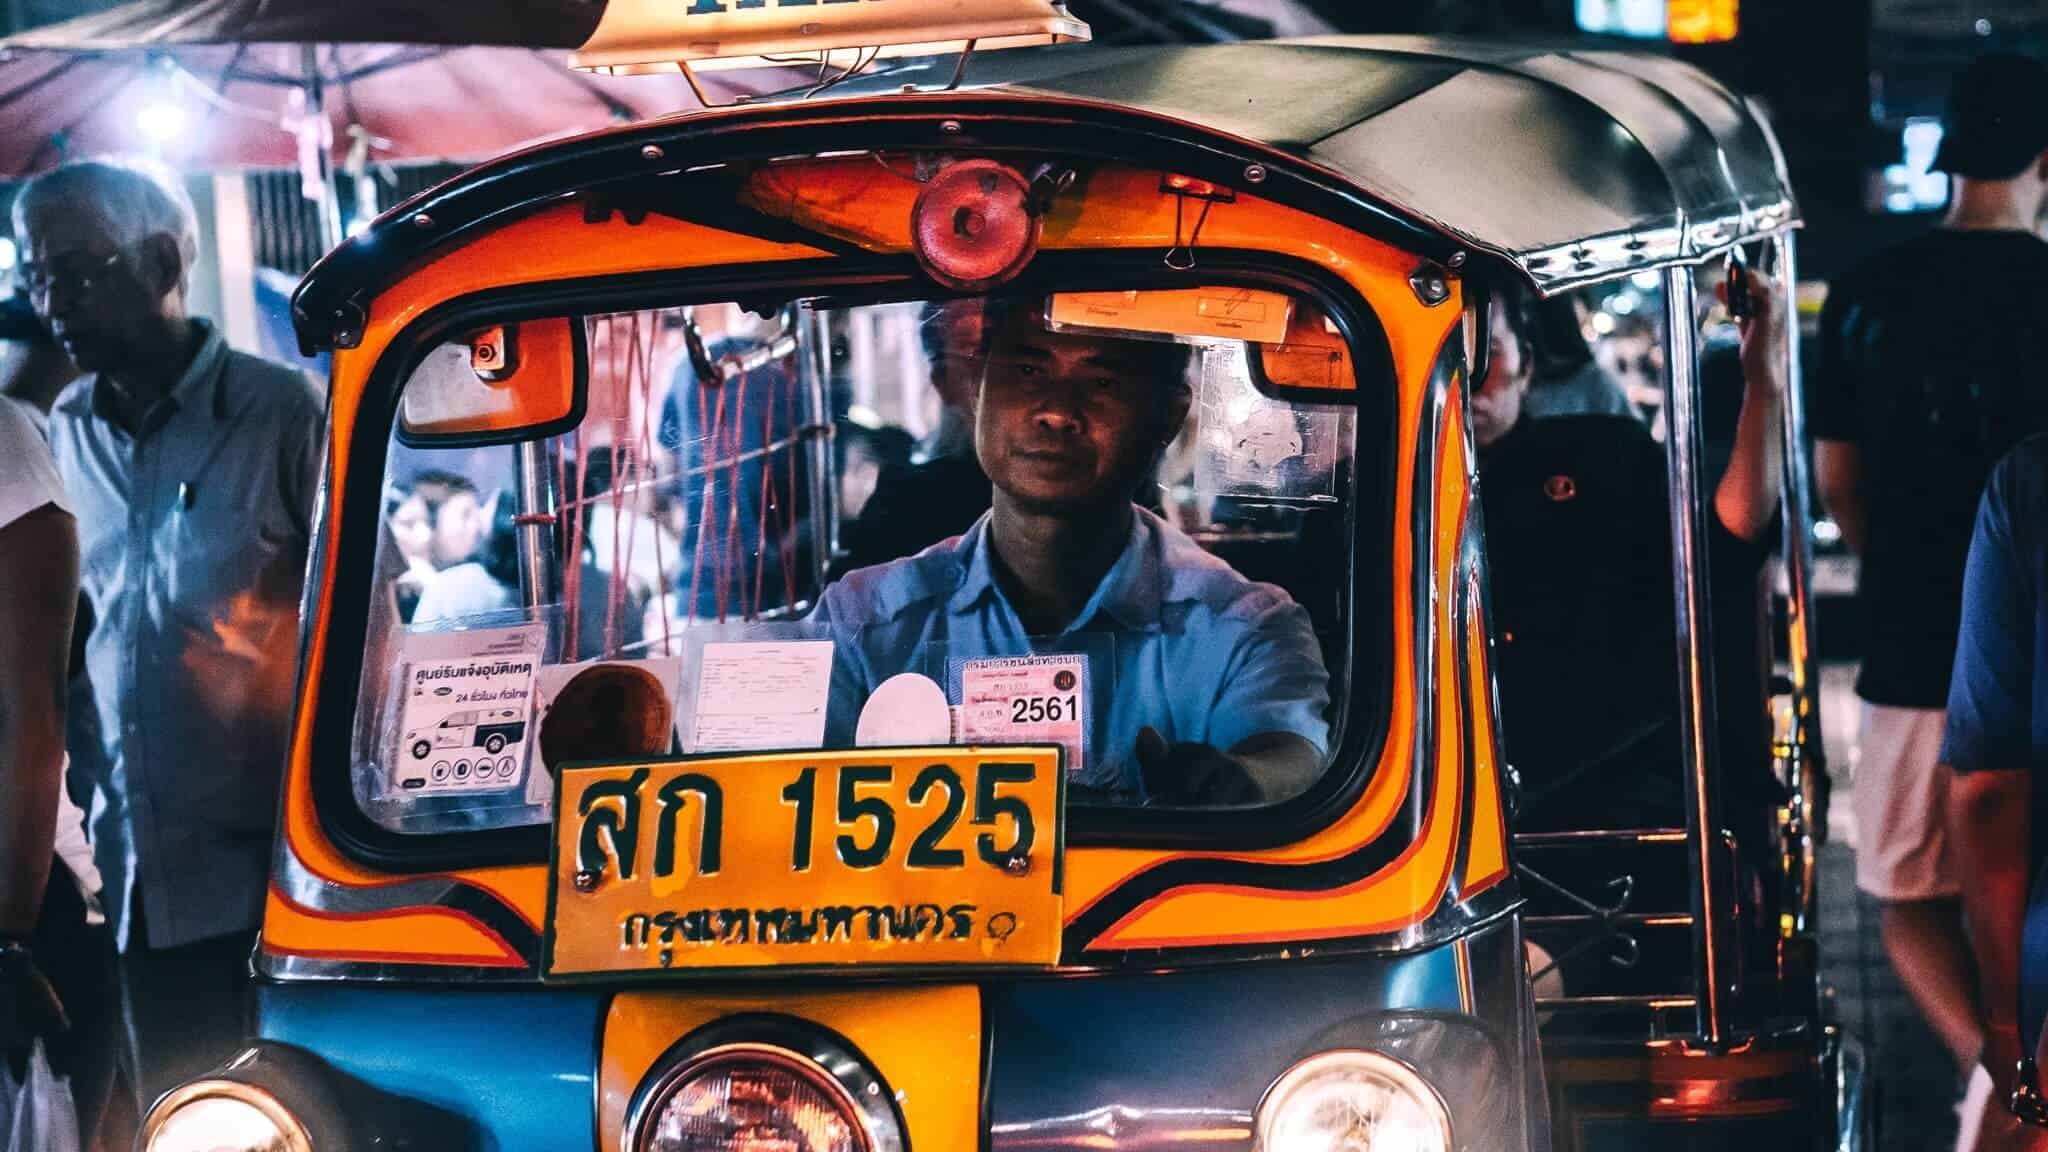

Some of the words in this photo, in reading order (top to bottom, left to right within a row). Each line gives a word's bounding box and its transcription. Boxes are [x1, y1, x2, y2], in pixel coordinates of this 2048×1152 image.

[416, 661, 532, 684] ศูนย์รับแจ้งอุบัติเหตุ
[455, 694, 468, 703] 24
[1012, 695, 1077, 723] 2561
[577, 767, 723, 880] สก
[783, 763, 1036, 873] 1525
[623, 904, 977, 967] กรุงเทพมหานคร
